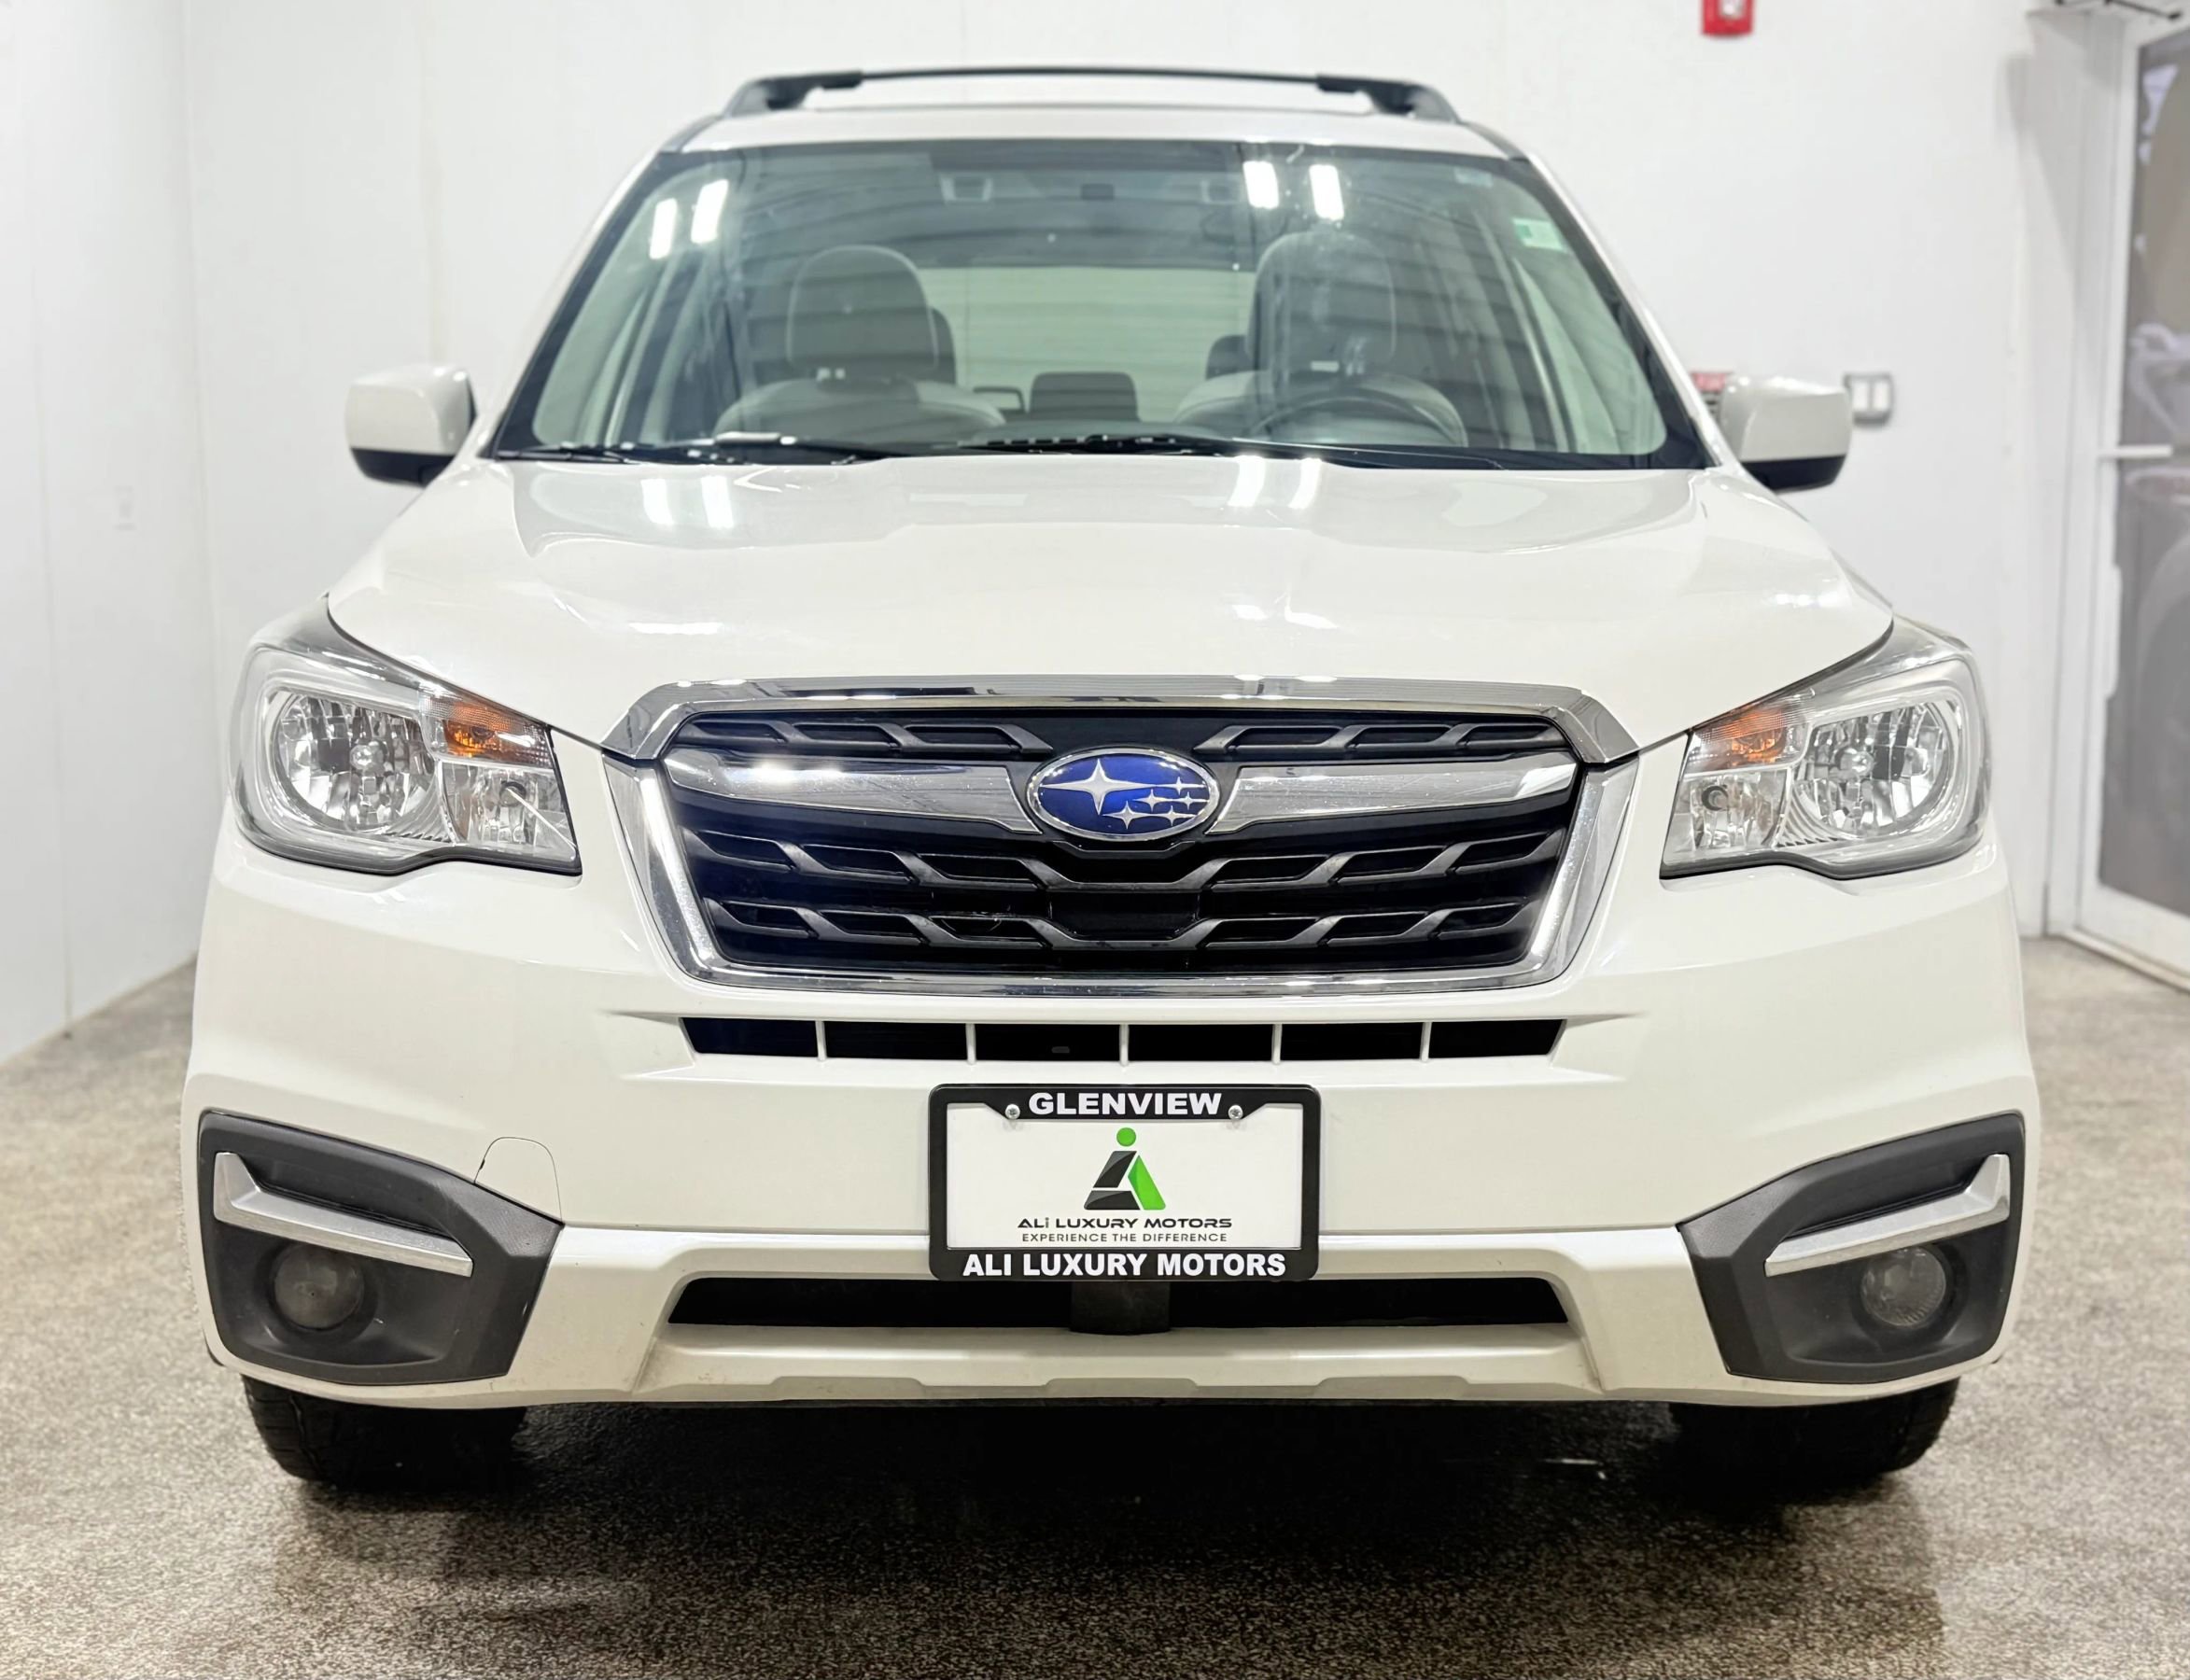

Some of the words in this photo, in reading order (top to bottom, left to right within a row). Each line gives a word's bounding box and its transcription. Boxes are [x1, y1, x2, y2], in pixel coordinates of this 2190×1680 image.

[1028, 1092, 1222, 1115] GLENVIEW
[1055, 1218, 1139, 1228] LUXURY
[1144, 1218, 1232, 1228] MOTORS
[1022, 1233, 1107, 1242] EXPERIENCE
[1112, 1233, 1137, 1242] THE
[1143, 1233, 1228, 1242] DIFFERENCE
[962, 1253, 1012, 1277] ALI
[1023, 1253, 1148, 1277] LUXURY
[1157, 1253, 1286, 1277] MOTORS
